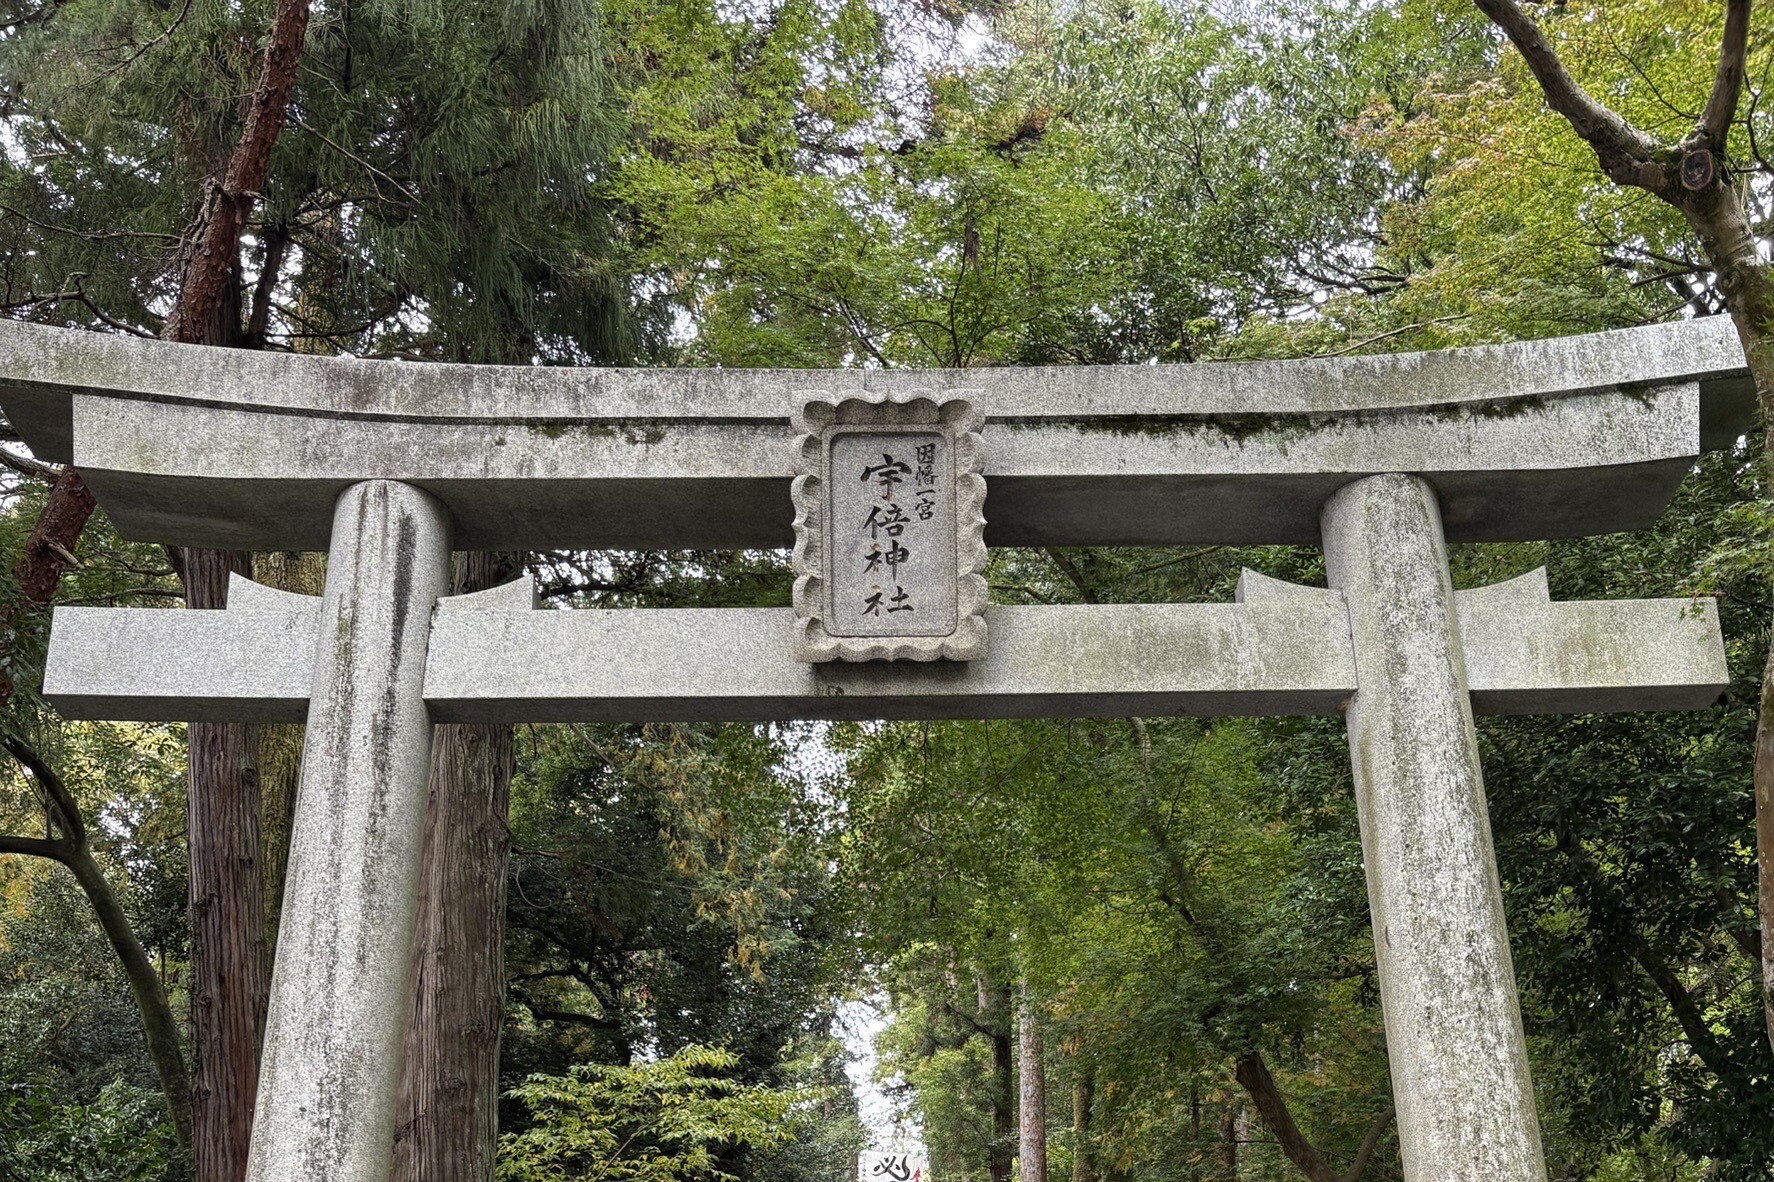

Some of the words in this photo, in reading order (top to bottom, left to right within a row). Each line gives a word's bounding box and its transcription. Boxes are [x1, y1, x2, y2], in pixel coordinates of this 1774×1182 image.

[862, 454, 915, 618] 宇倍神社
[915, 442, 939, 521] 因幡一宮
